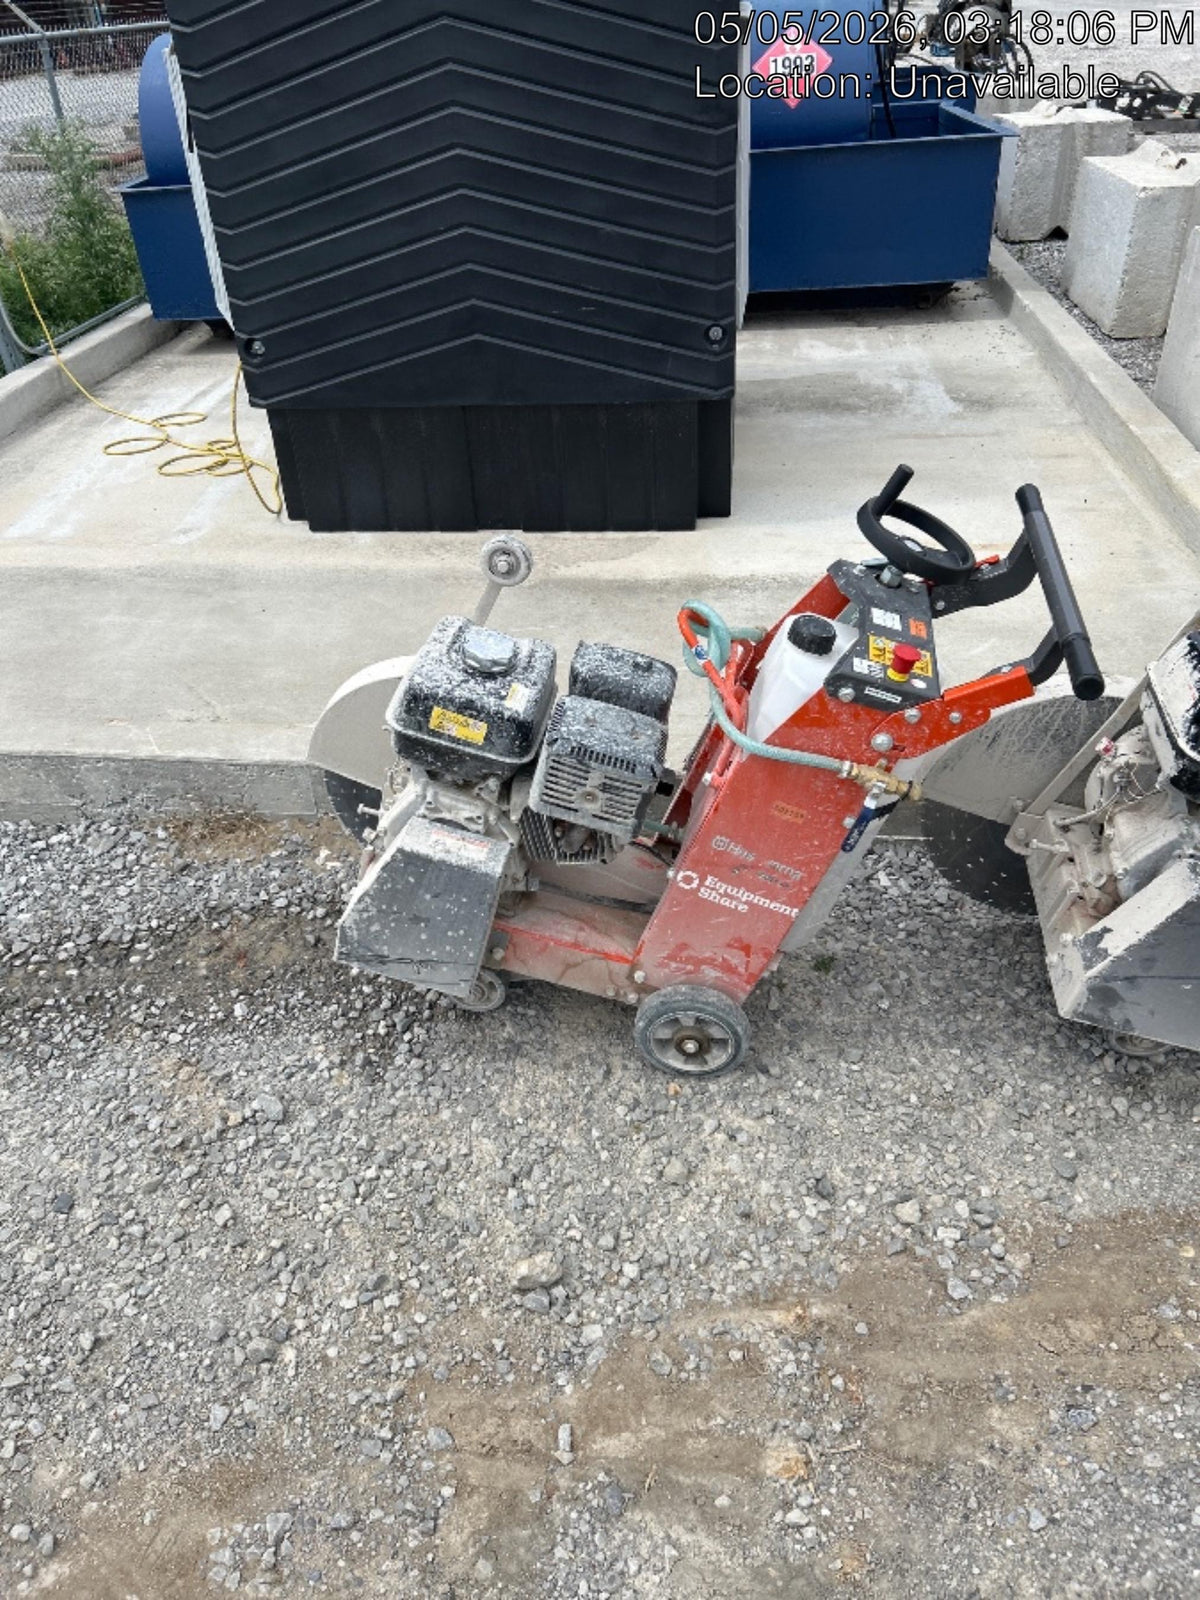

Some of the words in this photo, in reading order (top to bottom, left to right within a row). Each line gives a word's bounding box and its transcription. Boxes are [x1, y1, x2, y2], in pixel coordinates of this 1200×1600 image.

[771, 55, 815, 77] 1993
[698, 886, 748, 912] Share
[704, 874, 799, 918] Equipment
